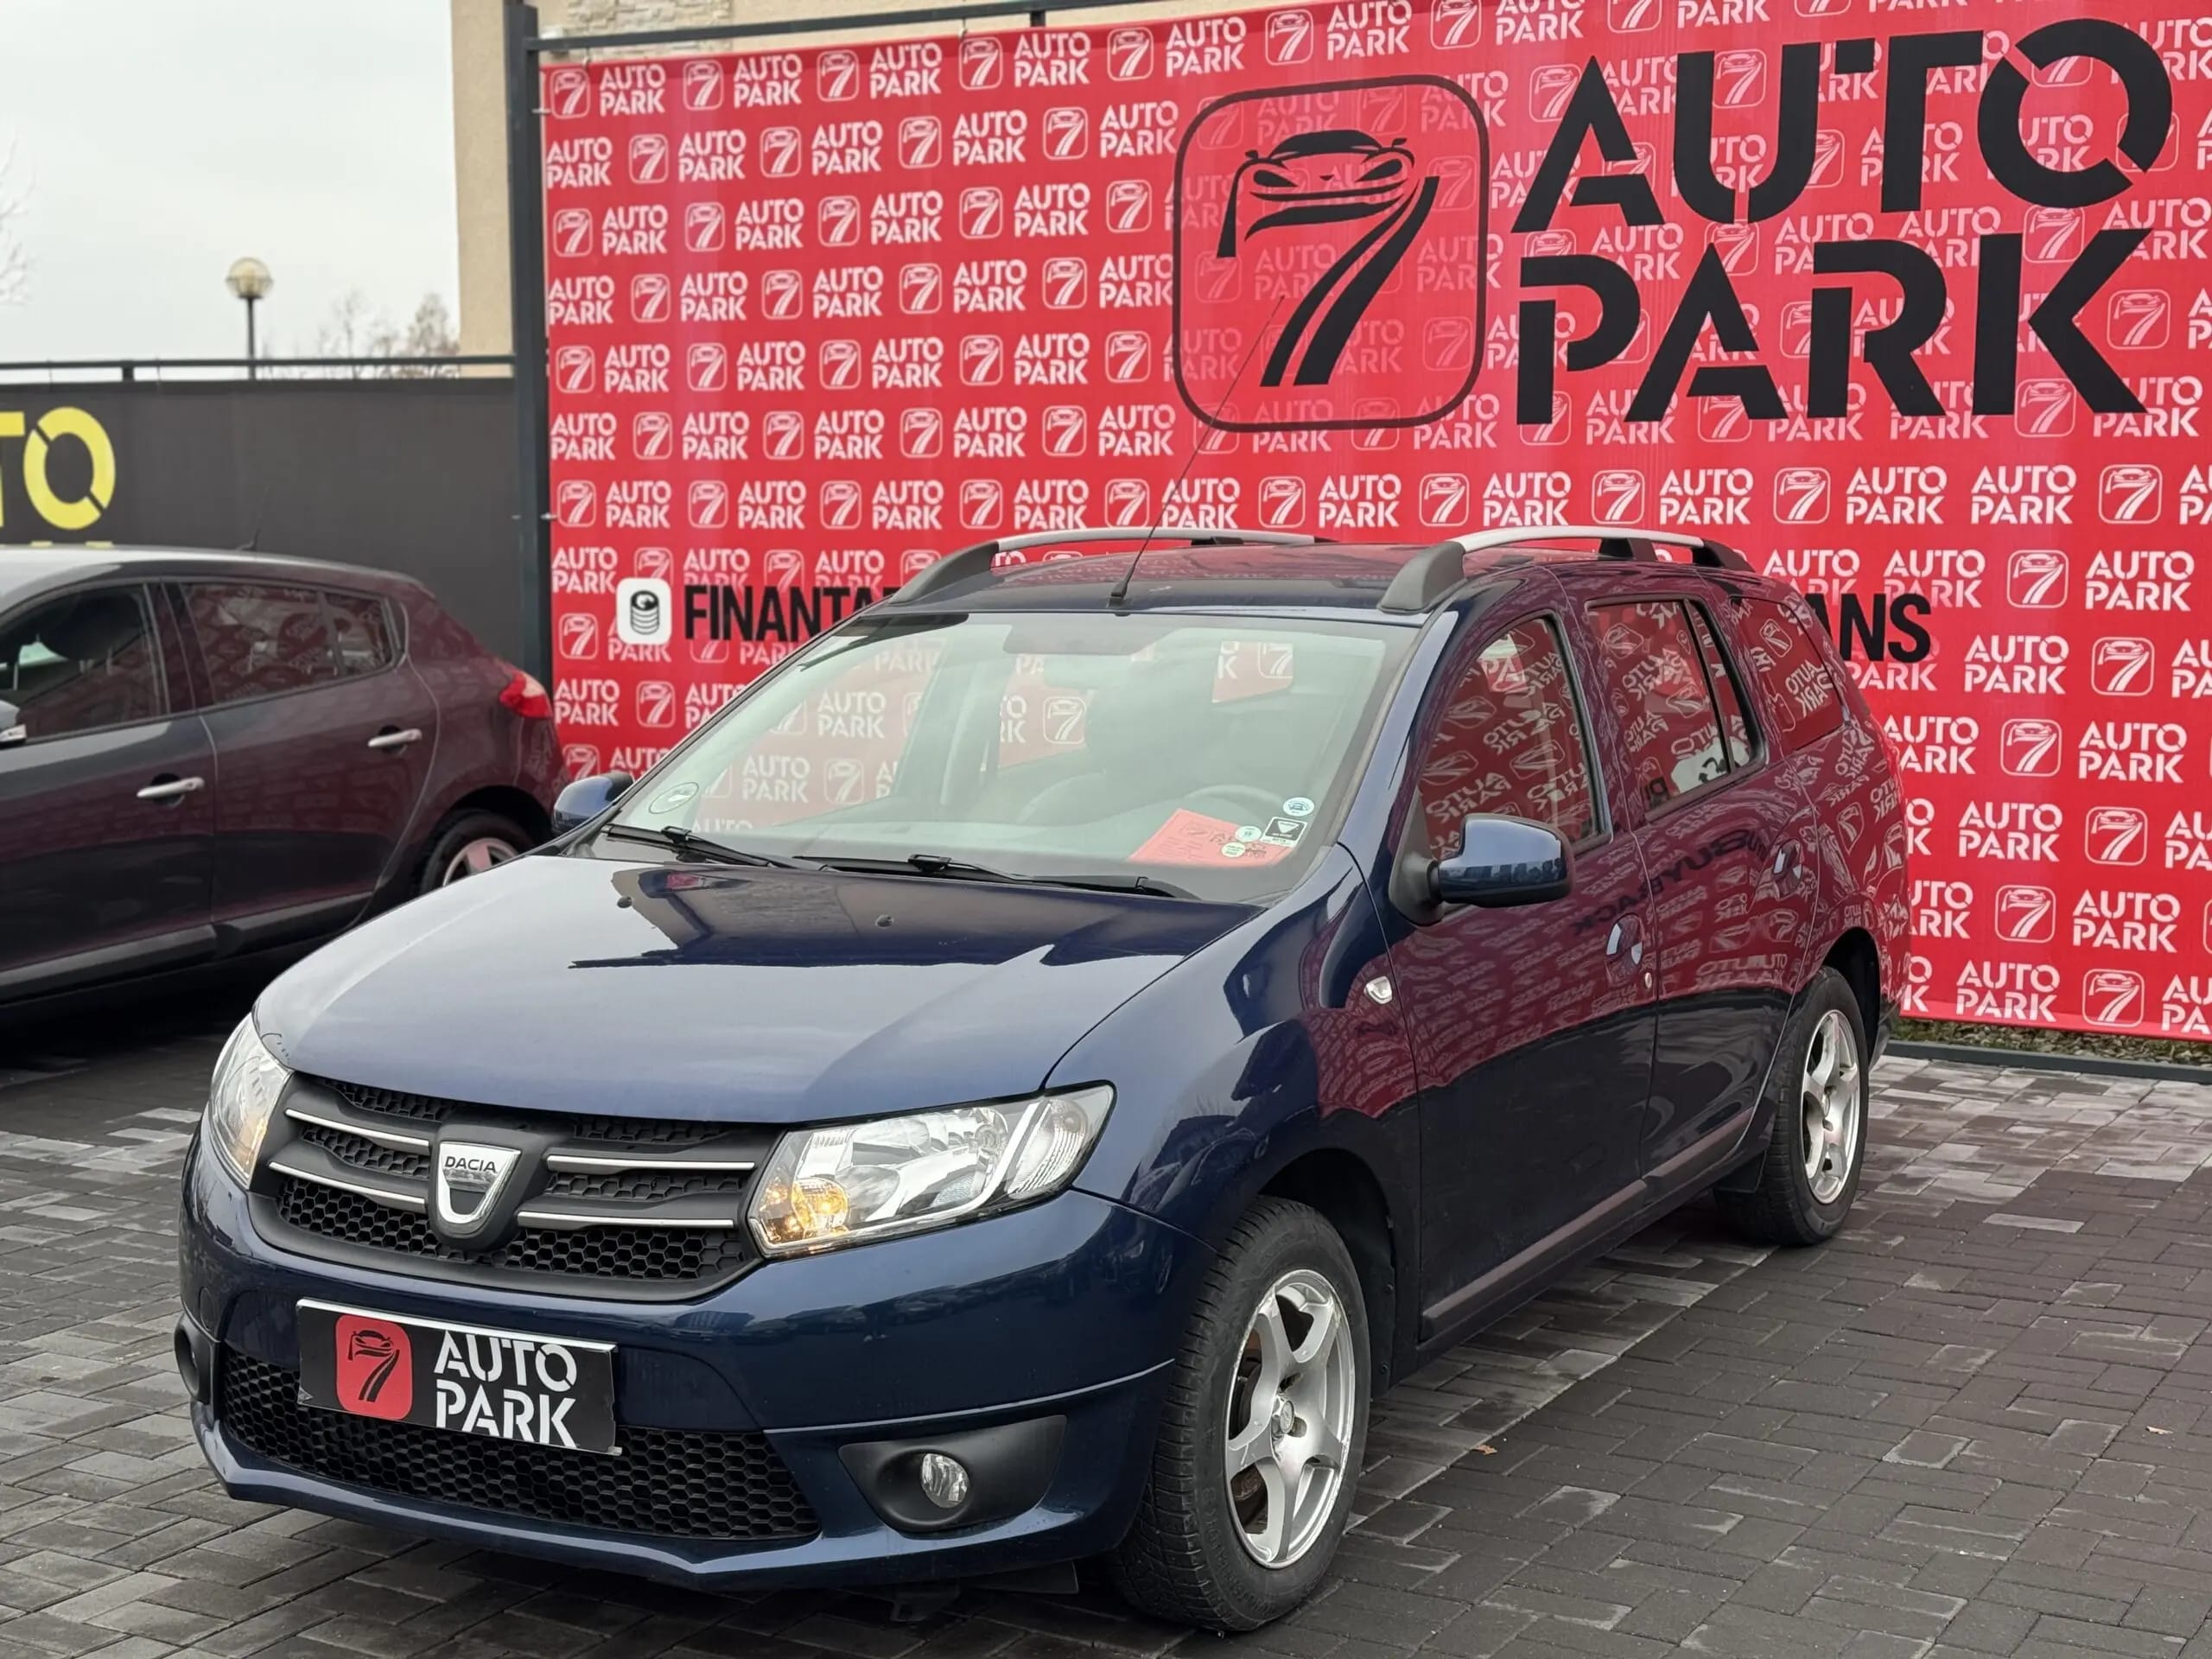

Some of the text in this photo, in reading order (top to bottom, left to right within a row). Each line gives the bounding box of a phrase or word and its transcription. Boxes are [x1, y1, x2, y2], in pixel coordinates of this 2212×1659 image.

[1328, 0, 1412, 31] AUTO
[1678, 0, 1770, 28] PARK
[1014, 30, 1090, 60] AUTO
[1167, 15, 1246, 48] AUTO
[1327, 26, 1410, 60] PARK
[1497, 17, 1583, 45] PARK
[733, 53, 802, 81] AUTO
[869, 41, 942, 72] AUTO
[1166, 43, 1244, 77] PARK
[600, 63, 665, 92] AUTO
[870, 68, 941, 99] PARK
[1014, 58, 1089, 87] PARK
[601, 87, 664, 116] PARK
[734, 78, 802, 108] PARK
[952, 109, 1027, 140] AUTO
[1099, 100, 1179, 132] AUTO
[1510, 18, 2172, 233] AUTO
[678, 129, 747, 157] AUTO
[811, 120, 883, 150] AUTO
[1100, 128, 1176, 158] PARK
[548, 137, 612, 164] AUTO
[812, 145, 881, 175] PARK
[953, 136, 1026, 166] PARK
[547, 162, 611, 189] PARK
[678, 153, 745, 182] PARK
[870, 190, 944, 219] AUTO
[1014, 182, 1090, 211] AUTO
[601, 205, 668, 231] AUTO
[734, 198, 804, 226] AUTO
[1014, 208, 1088, 238] PARK
[1900, 207, 2000, 238] AUTO
[2103, 198, 2212, 230] AUTO
[602, 228, 667, 256] PARK
[735, 223, 803, 251] PARK
[871, 215, 942, 245] PARK
[1592, 224, 1683, 255] AUTO
[1777, 213, 1873, 245] AUTO
[812, 265, 884, 293] AUTO
[953, 259, 1027, 287] AUTO
[1099, 254, 1173, 282] AUTO
[550, 276, 614, 302] AUTO
[680, 270, 748, 297] AUTO
[1099, 279, 1173, 308] PARK
[549, 299, 613, 326] PARK
[681, 295, 747, 321] PARK
[813, 290, 882, 318] PARK
[953, 284, 1026, 313] PARK
[1516, 227, 2153, 424] PARK
[604, 344, 671, 369] AUTO
[736, 340, 806, 366] AUTO
[871, 336, 944, 364] AUTO
[1014, 332, 1090, 360] AUTO
[605, 368, 669, 392] PARK
[737, 364, 804, 391] PARK
[872, 361, 942, 389] PARK
[1014, 358, 1088, 385] PARK
[550, 412, 617, 436] AUTO
[682, 410, 750, 435] AUTO
[814, 409, 885, 435] AUTO
[953, 406, 1027, 433] AUTO
[1098, 404, 1175, 430] AUTO
[1586, 416, 1675, 445] PARK
[1769, 413, 1863, 442] PARK
[1891, 411, 1988, 440] PARK
[2094, 408, 2200, 437] PARK
[550, 435, 615, 461] PARK
[683, 435, 748, 460] PARK
[815, 433, 883, 460] PARK
[954, 430, 1026, 458] PARK
[1098, 429, 1173, 456] PARK
[1253, 429, 1331, 453] PARK
[1414, 422, 1497, 449] PARK
[606, 480, 671, 505] AUTO
[738, 480, 806, 505] AUTO
[872, 480, 944, 505] AUTO
[1014, 479, 1089, 505] AUTO
[1161, 478, 1240, 504] AUTO
[1319, 474, 1402, 501] AUTO
[1483, 473, 1571, 499] AUTO
[1660, 469, 1753, 496] AUTO
[1846, 466, 1947, 495] AUTO
[1971, 465, 2076, 494] AUTO
[606, 504, 671, 528] PARK
[738, 504, 805, 530] PARK
[872, 505, 942, 530] PARK
[1014, 504, 1087, 530] PARK
[1161, 504, 1237, 529] PARK
[1319, 499, 1399, 528] PARK
[1484, 499, 1568, 527] PARK
[1660, 498, 1750, 524] PARK
[1847, 494, 1944, 524] PARK
[1971, 495, 2074, 524] PARK
[552, 547, 617, 570] AUTO
[683, 548, 750, 572] AUTO
[815, 550, 885, 575] AUTO
[1764, 550, 1859, 578] AUTO
[1884, 550, 1986, 579] AUTO
[2085, 550, 2195, 581] AUTO
[552, 569, 615, 594] PARK
[1884, 579, 1982, 608] PARK
[2085, 581, 2191, 612] PARK
[1964, 635, 2069, 664] AUTO
[553, 678, 620, 702] AUTO
[1964, 664, 2066, 695] PARK
[554, 701, 619, 726] PARK
[818, 691, 887, 715] AUTO
[818, 715, 885, 739] PARK
[1883, 715, 1980, 746] AUTO
[2078, 721, 2187, 753] AUTO
[741, 754, 810, 779] AUTO
[1900, 745, 1975, 774] ARK
[2079, 750, 2184, 783] PARK
[742, 778, 809, 803] PARK
[1959, 801, 2063, 832] AUTO
[1959, 830, 2060, 862] PARK
[2073, 889, 2181, 923] AUTO
[2073, 918, 2177, 953] PARK
[1956, 960, 2060, 993] AUTO
[1956, 988, 2056, 1020] PARK
[444, 1156, 496, 1173] DACIA
[433, 1330, 577, 1392] AUTO
[435, 1379, 577, 1447] PARK
